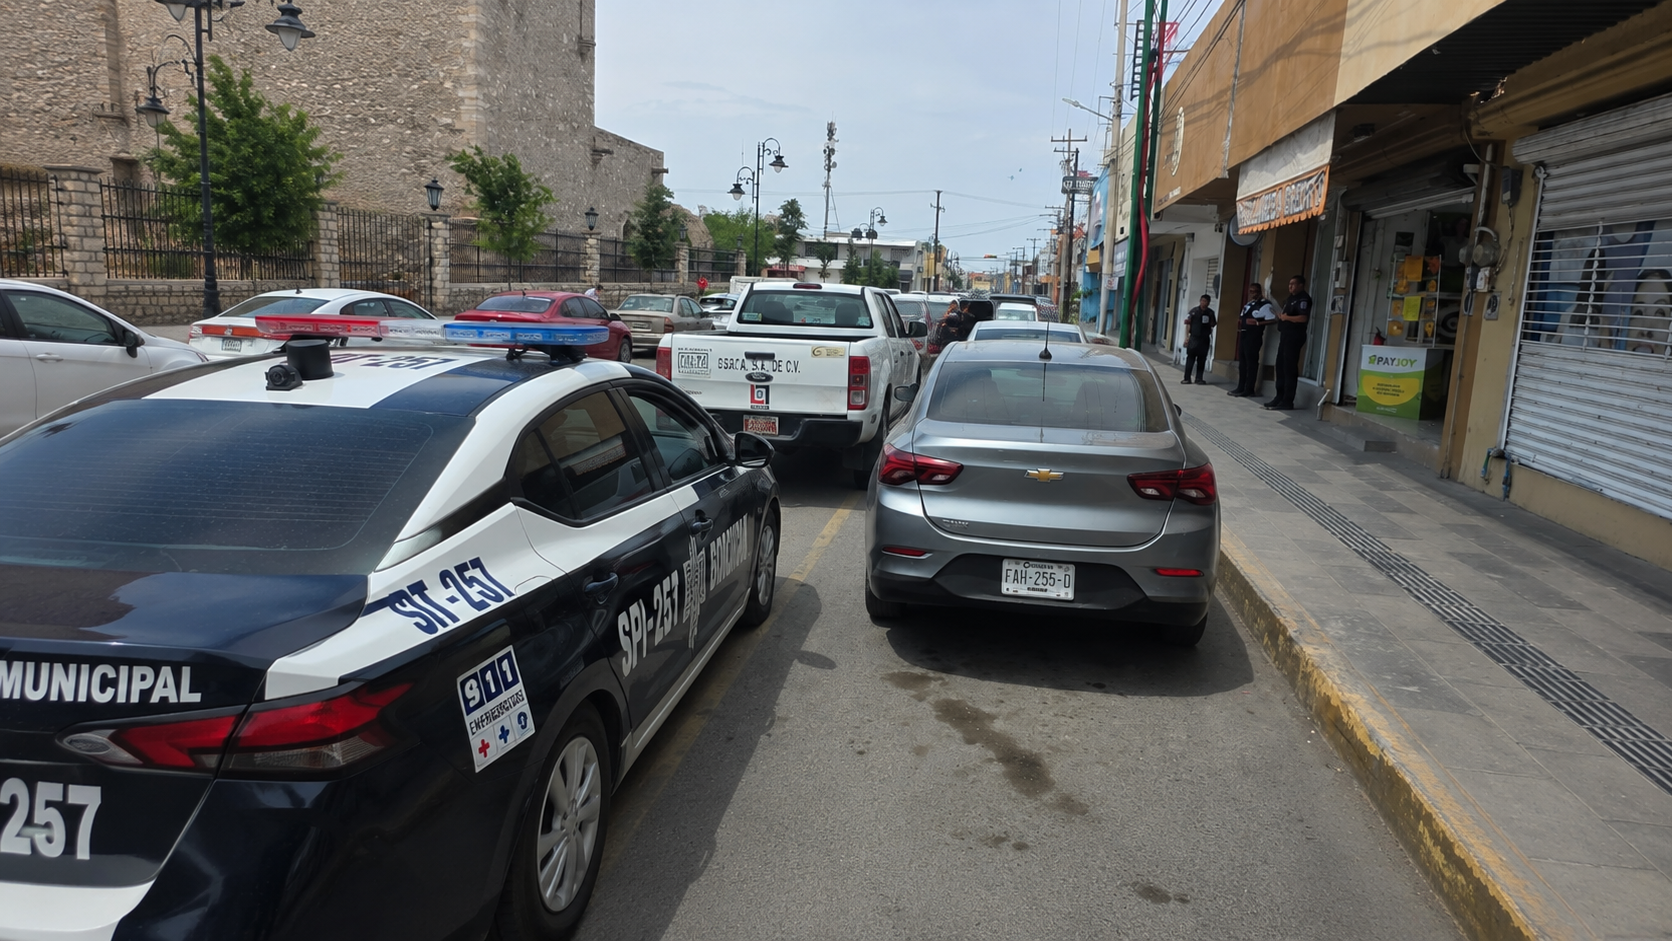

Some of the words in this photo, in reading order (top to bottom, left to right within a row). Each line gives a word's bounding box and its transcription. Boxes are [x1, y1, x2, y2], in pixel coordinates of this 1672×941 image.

[772, 360, 783, 373] DE
[786, 360, 801, 373] C.V.
[1377, 357, 1417, 368] PAYJOY
[618, 569, 679, 677] SPI-257
[0, 660, 202, 703] MUNICIPAL
[464, 658, 513, 708] 911
[0, 777, 102, 860] 257
